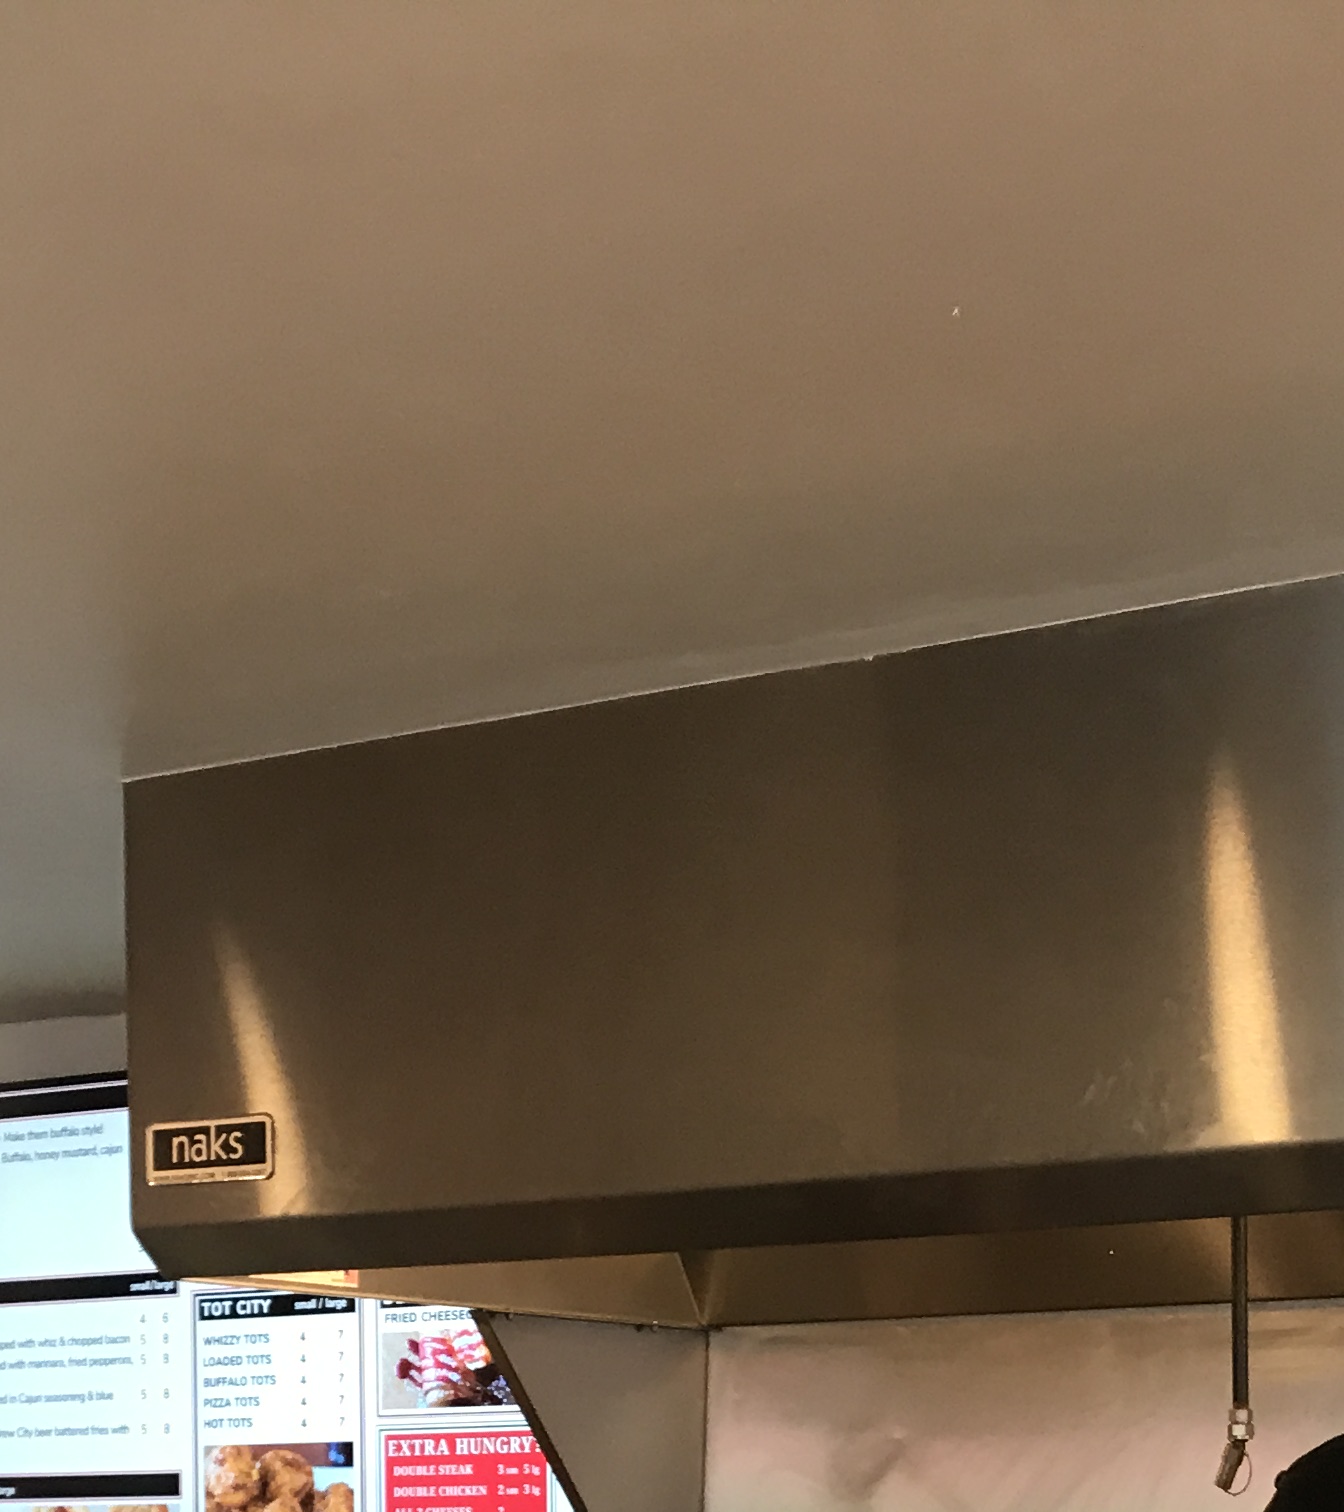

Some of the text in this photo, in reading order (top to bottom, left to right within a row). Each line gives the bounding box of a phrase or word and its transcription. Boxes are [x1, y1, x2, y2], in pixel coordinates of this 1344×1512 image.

[171, 1125, 244, 1163] naks
[201, 1300, 233, 1317] TOT
[236, 1299, 272, 1315] CITY
[139, 1314, 146, 1324] 4
[384, 1312, 417, 1323] FRIED
[203, 1330, 344, 1346] WHIZZY TOTS 4 7
[203, 1351, 344, 1367] LOADED TOTS 4 7
[203, 1373, 344, 1388] BUFFALO TOTS 4 7
[203, 1395, 345, 1408] PIZZA TOTS 4 7
[204, 1417, 345, 1429] HOT TOTS 4 7
[388, 1438, 450, 1457] EXTRA
[393, 1465, 436, 1476] DOUBLE
[438, 1464, 474, 1475] STEAK
[497, 1464, 505, 1475] 3
[522, 1463, 530, 1475] 5
[393, 1486, 436, 1497] DOUBLE
[438, 1485, 488, 1496] CHICKEN
[497, 1484, 505, 1495] 2
[522, 1484, 530, 1495] 3
